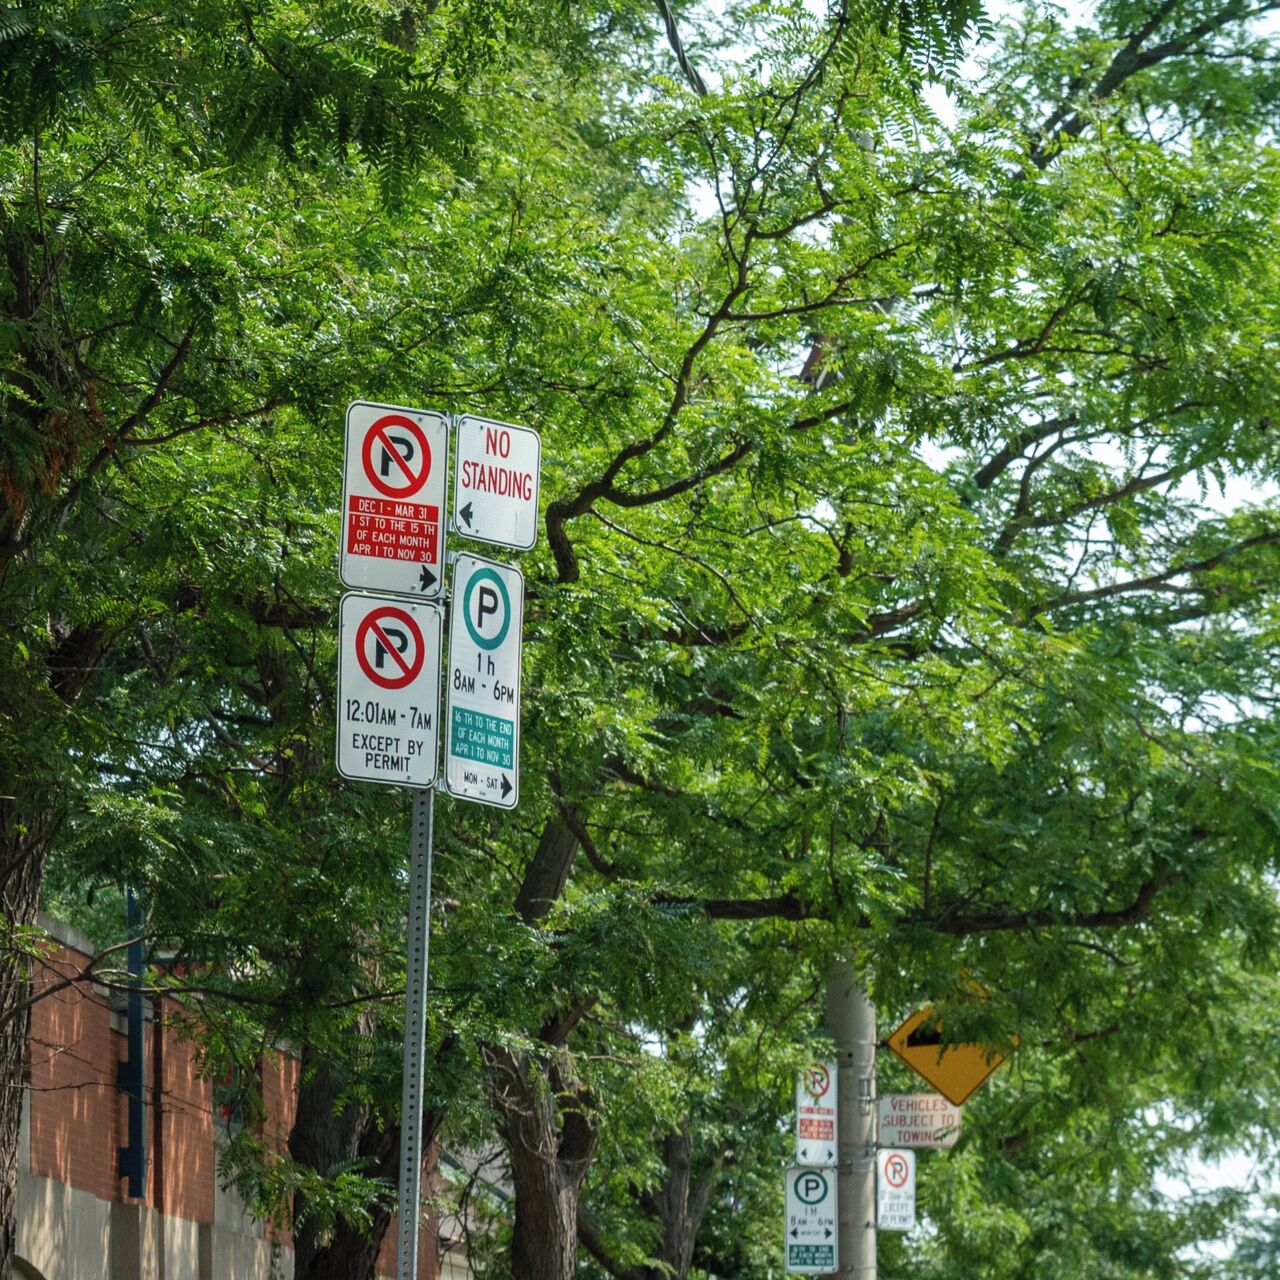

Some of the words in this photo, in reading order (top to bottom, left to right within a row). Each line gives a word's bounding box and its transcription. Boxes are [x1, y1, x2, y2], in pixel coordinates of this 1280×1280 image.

[486, 426, 511, 458] NO
[462, 460, 532, 501] STANDING
[358, 499, 376, 513] DEC
[379, 502, 383, 514] 1
[395, 503, 415, 518] MAR
[418, 507, 427, 519] 31
[352, 515, 356, 525] 1
[359, 516, 370, 527] ST
[374, 518, 386, 529] TO
[390, 520, 406, 532] THE
[410, 523, 419, 534] 15
[423, 524, 434, 535] TH
[356, 529, 368, 540] OF
[372, 531, 396, 544] EACH
[399, 536, 430, 548] MONTH
[352, 543, 371, 555] APR
[375, 546, 379, 556] 1
[383, 546, 394, 558] TO
[397, 549, 416, 560] NOV
[420, 551, 432, 562] 30
[477, 652, 482, 673] 1
[487, 655, 495, 676] h
[454, 668, 475, 694] 8AM
[493, 680, 514, 704] 6PM
[346, 698, 397, 726] 12:01AM
[410, 706, 432, 731] 7AM
[455, 710, 462, 722] 16
[464, 712, 473, 725] TH
[475, 715, 483, 728] TO
[486, 718, 497, 732] THE
[500, 722, 512, 736] END
[352, 733, 401, 754] EXCEPT
[407, 739, 424, 756] BY
[457, 727, 466, 739] OF
[469, 729, 486, 744] EACH
[487, 734, 509, 750] MONTH
[365, 752, 411, 772] PERMIT
[455, 742, 468, 756] APR
[471, 745, 474, 757] 1
[476, 746, 485, 759] TO
[487, 749, 500, 763] NOV
[502, 753, 511, 766] 30
[464, 771, 478, 785] MON
[486, 776, 498, 789] SAT
[891, 1097, 948, 1112] VEHICLES
[882, 1114, 934, 1128] SUBJECT
[942, 1114, 955, 1127] TO
